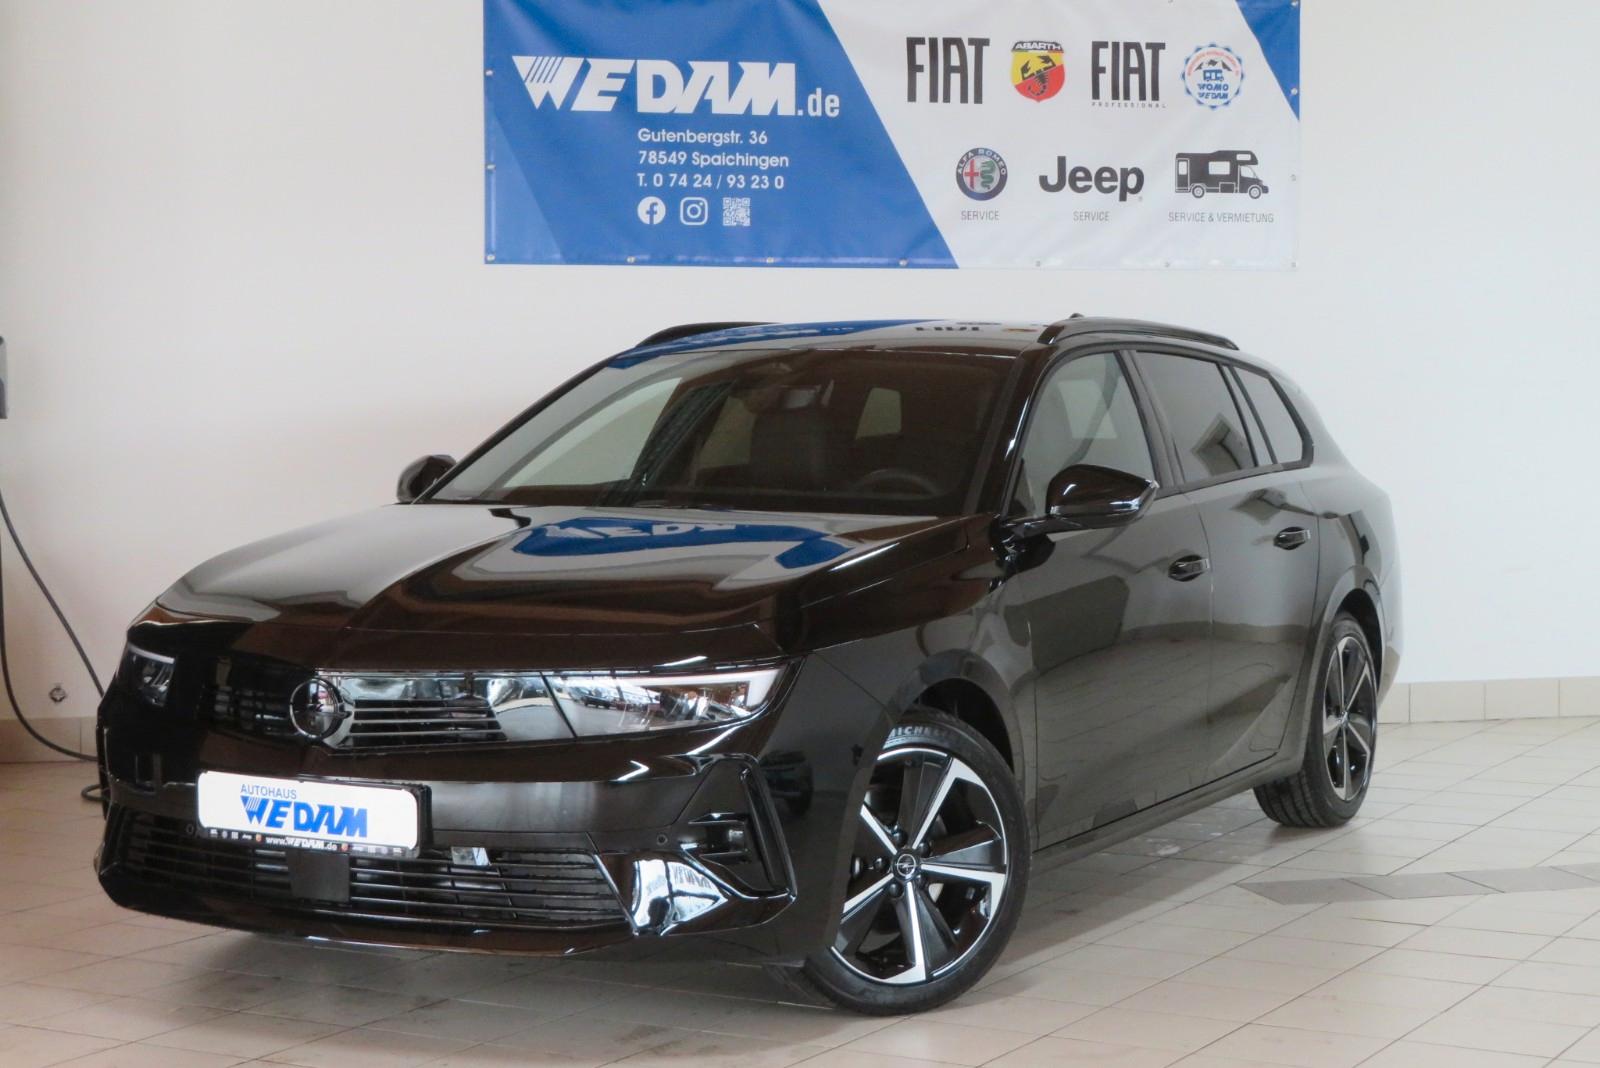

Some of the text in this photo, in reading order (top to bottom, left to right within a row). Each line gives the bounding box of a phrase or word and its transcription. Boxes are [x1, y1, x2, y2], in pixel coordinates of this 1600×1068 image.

[1014, 42, 1062, 51] ABARTH
[906, 37, 990, 104] FIAT
[1091, 40, 1166, 101] FIAT
[637, 128, 768, 147] Gutenbergstr. 36
[638, 150, 790, 170] 78549 Spaichingen
[957, 148, 1007, 176] ALFA ROMEO
[637, 173, 647, 187] T.
[653, 173, 663, 187] 0
[669, 173, 688, 187] 74
[693, 174, 712, 188] 24
[726, 174, 746, 189] 93
[751, 175, 769, 189] 23
[774, 176, 784, 190] 0
[1038, 155, 1145, 202] Jeep
[960, 210, 1000, 221] SERVICE
[1073, 211, 1110, 222] SERVICE
[1168, 211, 1275, 223] SERVICE & VERMIETUNG
[240, 783, 297, 800] AUTOHAUS
[240, 795, 368, 838] WEDAM
